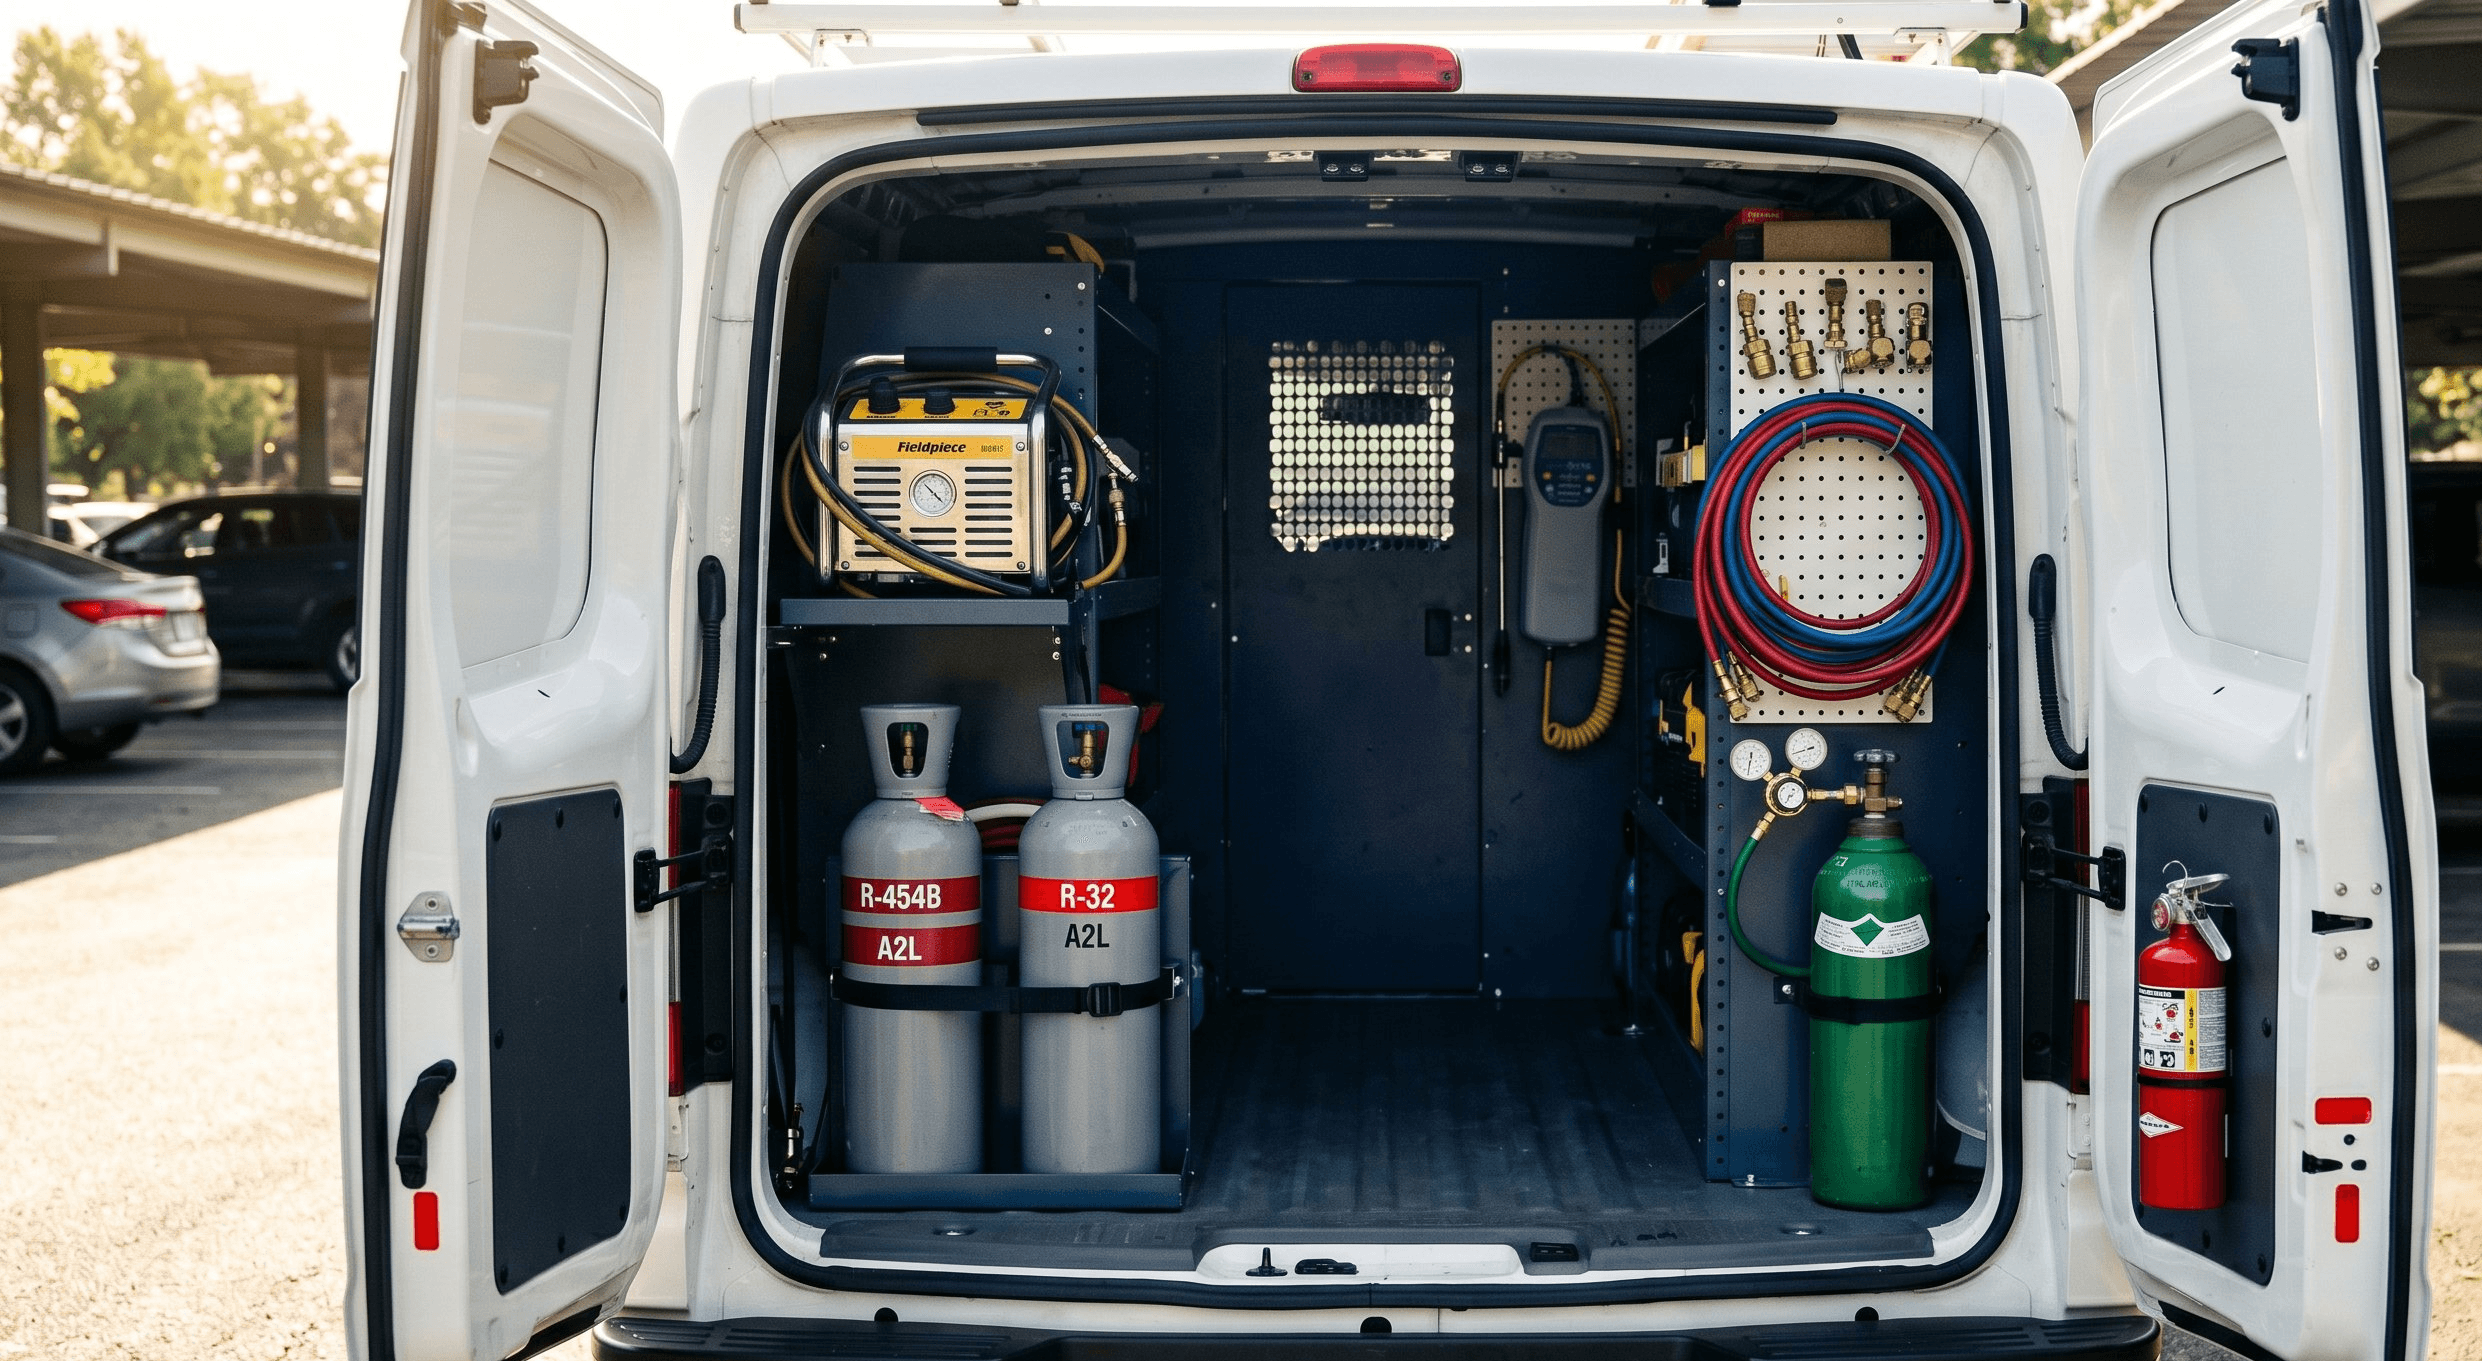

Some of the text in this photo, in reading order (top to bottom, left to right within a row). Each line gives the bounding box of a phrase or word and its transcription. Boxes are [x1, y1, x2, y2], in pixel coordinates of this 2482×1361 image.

[897, 441, 967, 455] Fieldpiece
[860, 883, 942, 909] R-454B
[1060, 884, 1116, 909] R-32
[877, 936, 923, 961] A2L
[1064, 923, 1110, 949] A2L
